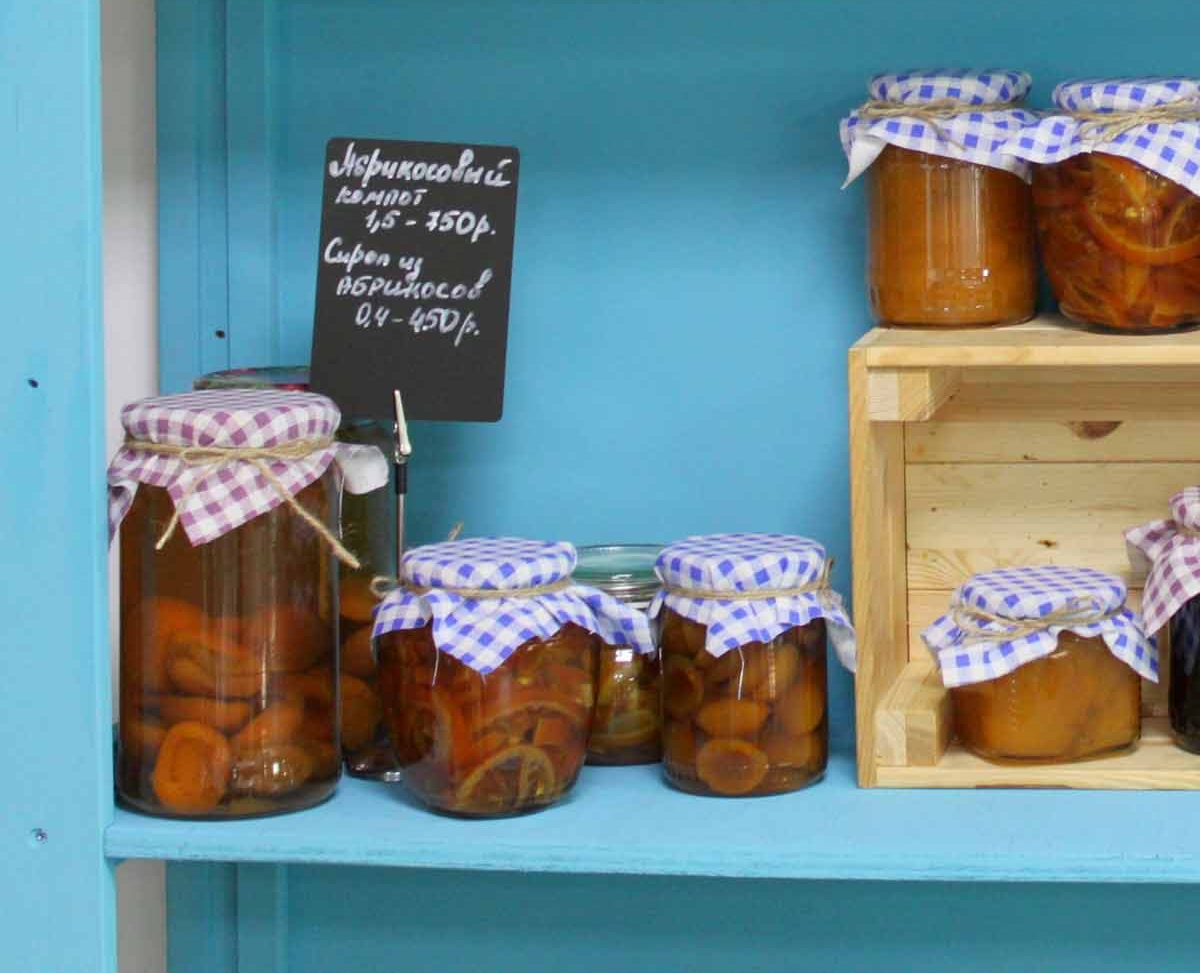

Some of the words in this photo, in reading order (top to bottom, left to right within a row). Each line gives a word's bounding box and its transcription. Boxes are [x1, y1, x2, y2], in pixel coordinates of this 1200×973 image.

[329, 142, 512, 188] Абрикосовый
[365, 210, 401, 233] 1,5
[324, 237, 391, 272] Сироп
[355, 303, 391, 328] 0,4
